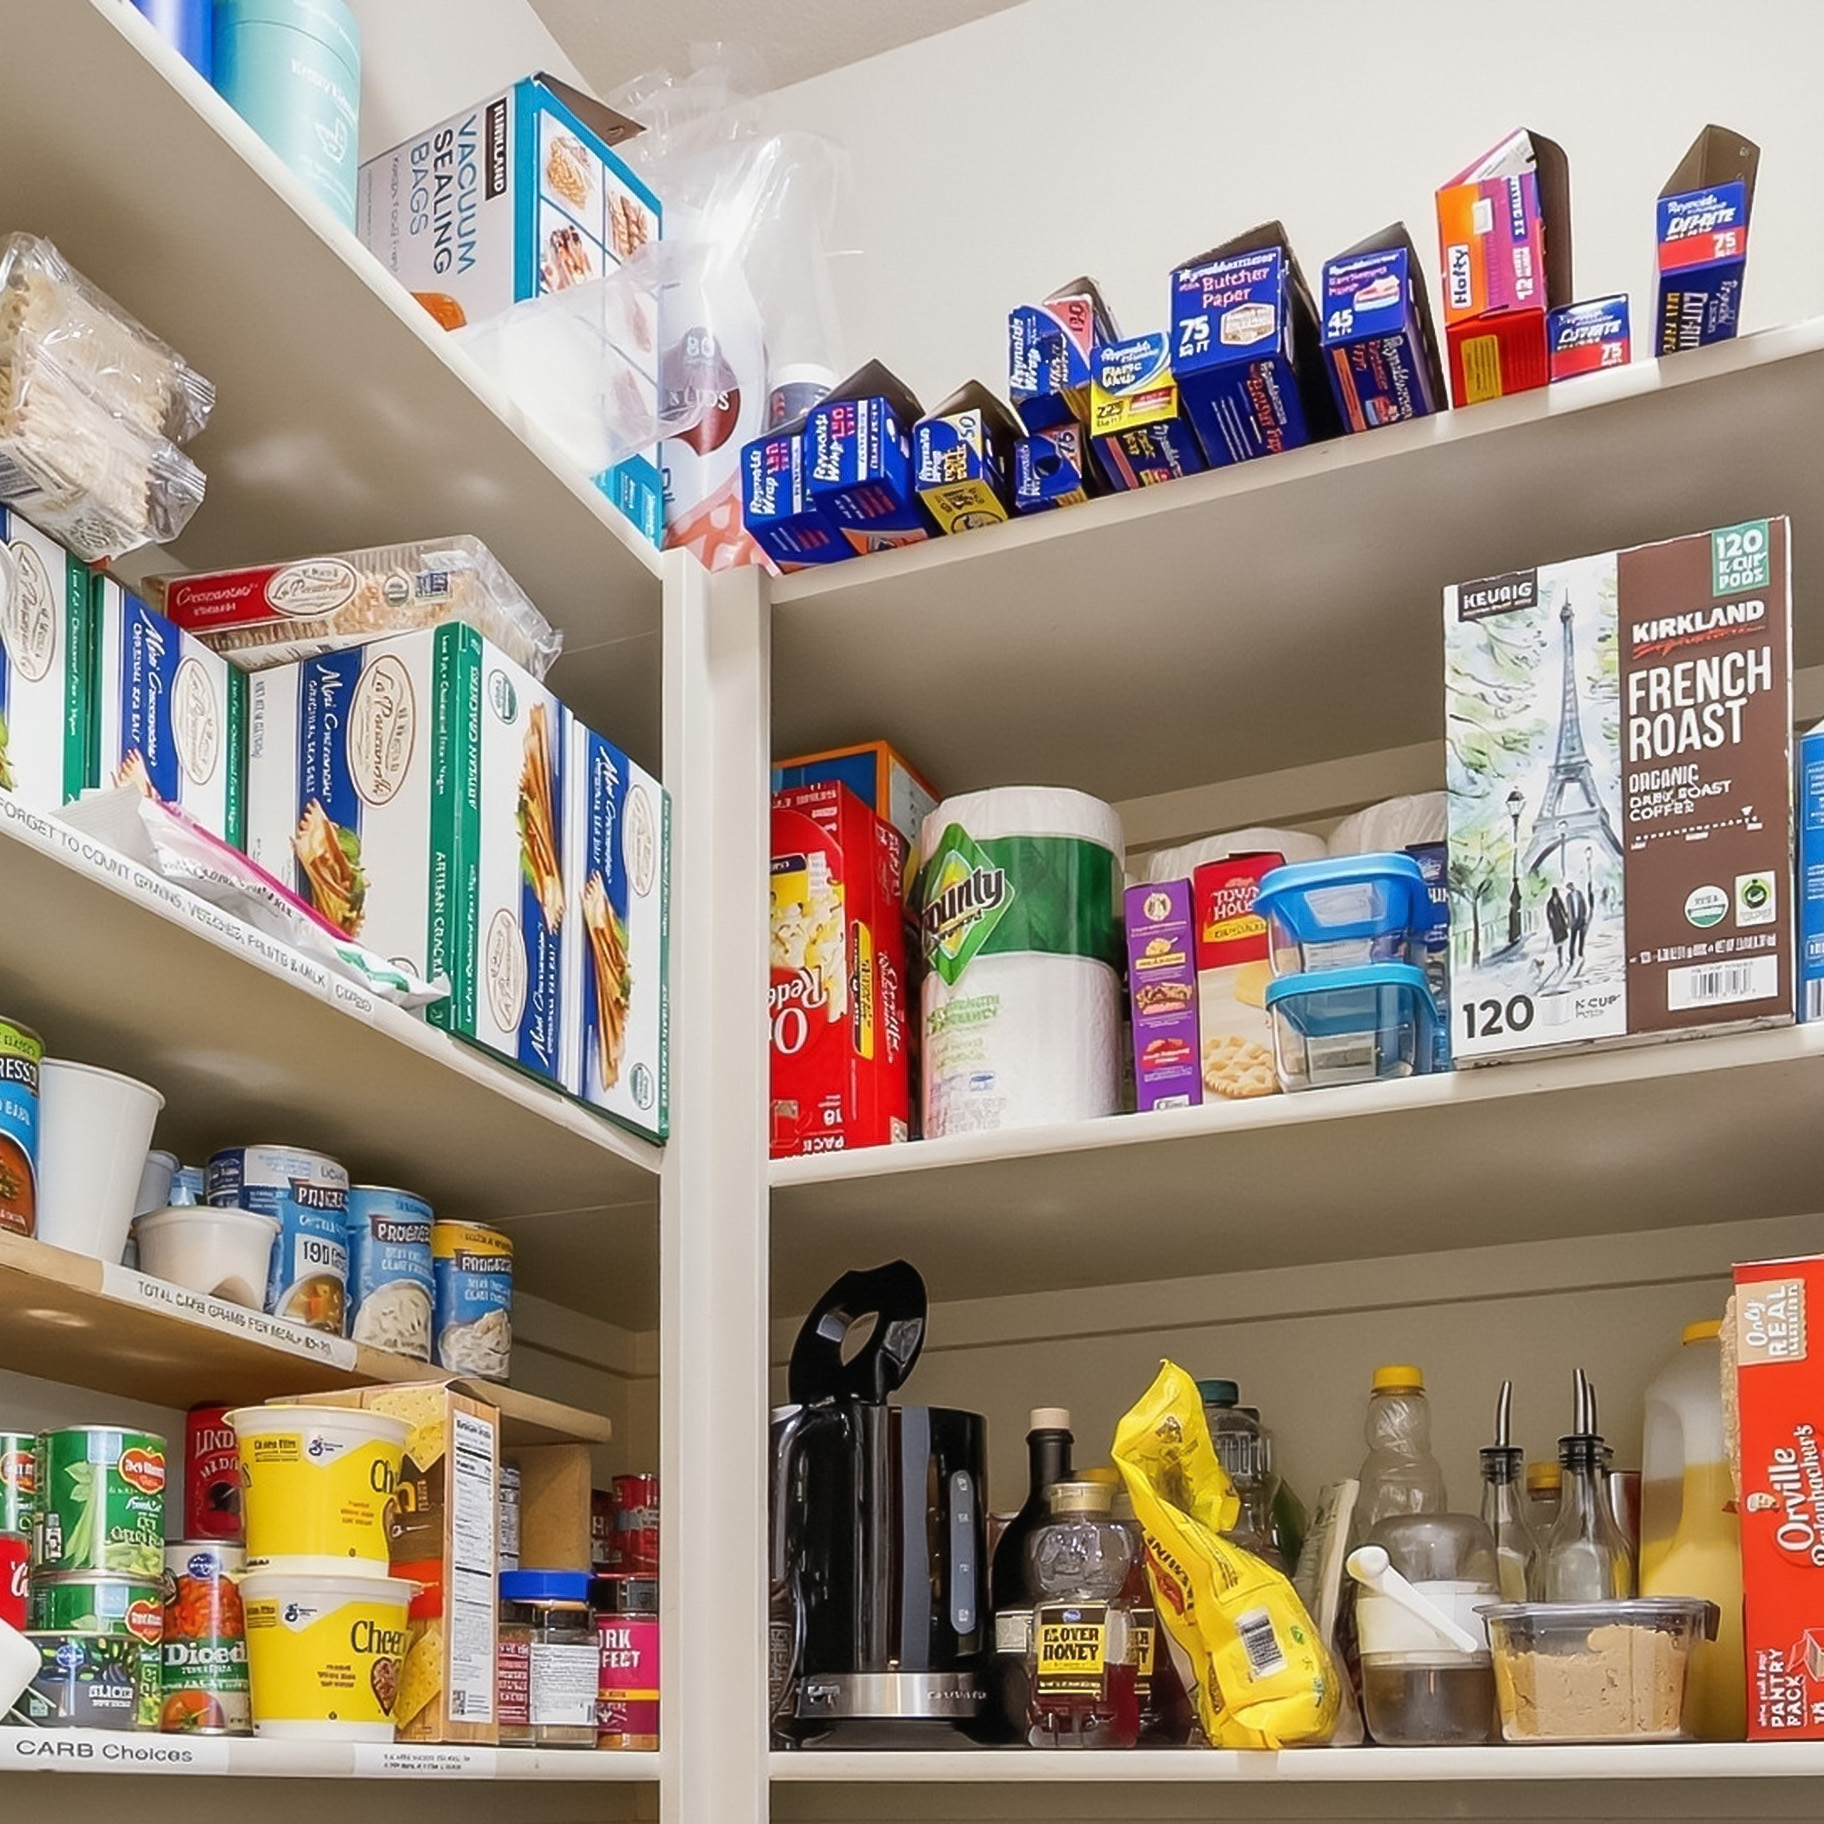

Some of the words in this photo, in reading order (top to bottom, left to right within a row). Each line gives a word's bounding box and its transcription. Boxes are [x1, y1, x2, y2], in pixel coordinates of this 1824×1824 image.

[409, 139, 431, 237] BAGS
[432, 127, 455, 275] SEALING
[456, 114, 479, 275] VACUUM
[1713, 234, 1737, 252] 75
[1201, 268, 1271, 292] Butcher
[1178, 316, 1210, 343] 75
[1328, 309, 1353, 329] 45
[1600, 343, 1623, 361] 75
[1717, 530, 1764, 558] 120
[1463, 582, 1533, 610] KEURIG
[1719, 568, 1766, 589] PODS
[1632, 600, 1765, 643] KIRKLAND
[1628, 646, 1773, 715] FRENCH
[1628, 698, 1748, 761] ROAST
[59, 829, 80, 855] TO
[82, 843, 133, 881] COUNT
[1462, 993, 1534, 1039] 120
[1746, 1299, 1767, 1348] Only
[1767, 1284, 1786, 1357] REAL
[1767, 1447, 1815, 1552] Orville
[1772, 1648, 1785, 1728] PANTRY
[1787, 1675, 1803, 1727] PACK
[16, 1739, 94, 1759] CARB
[102, 1742, 193, 1763] Choices
